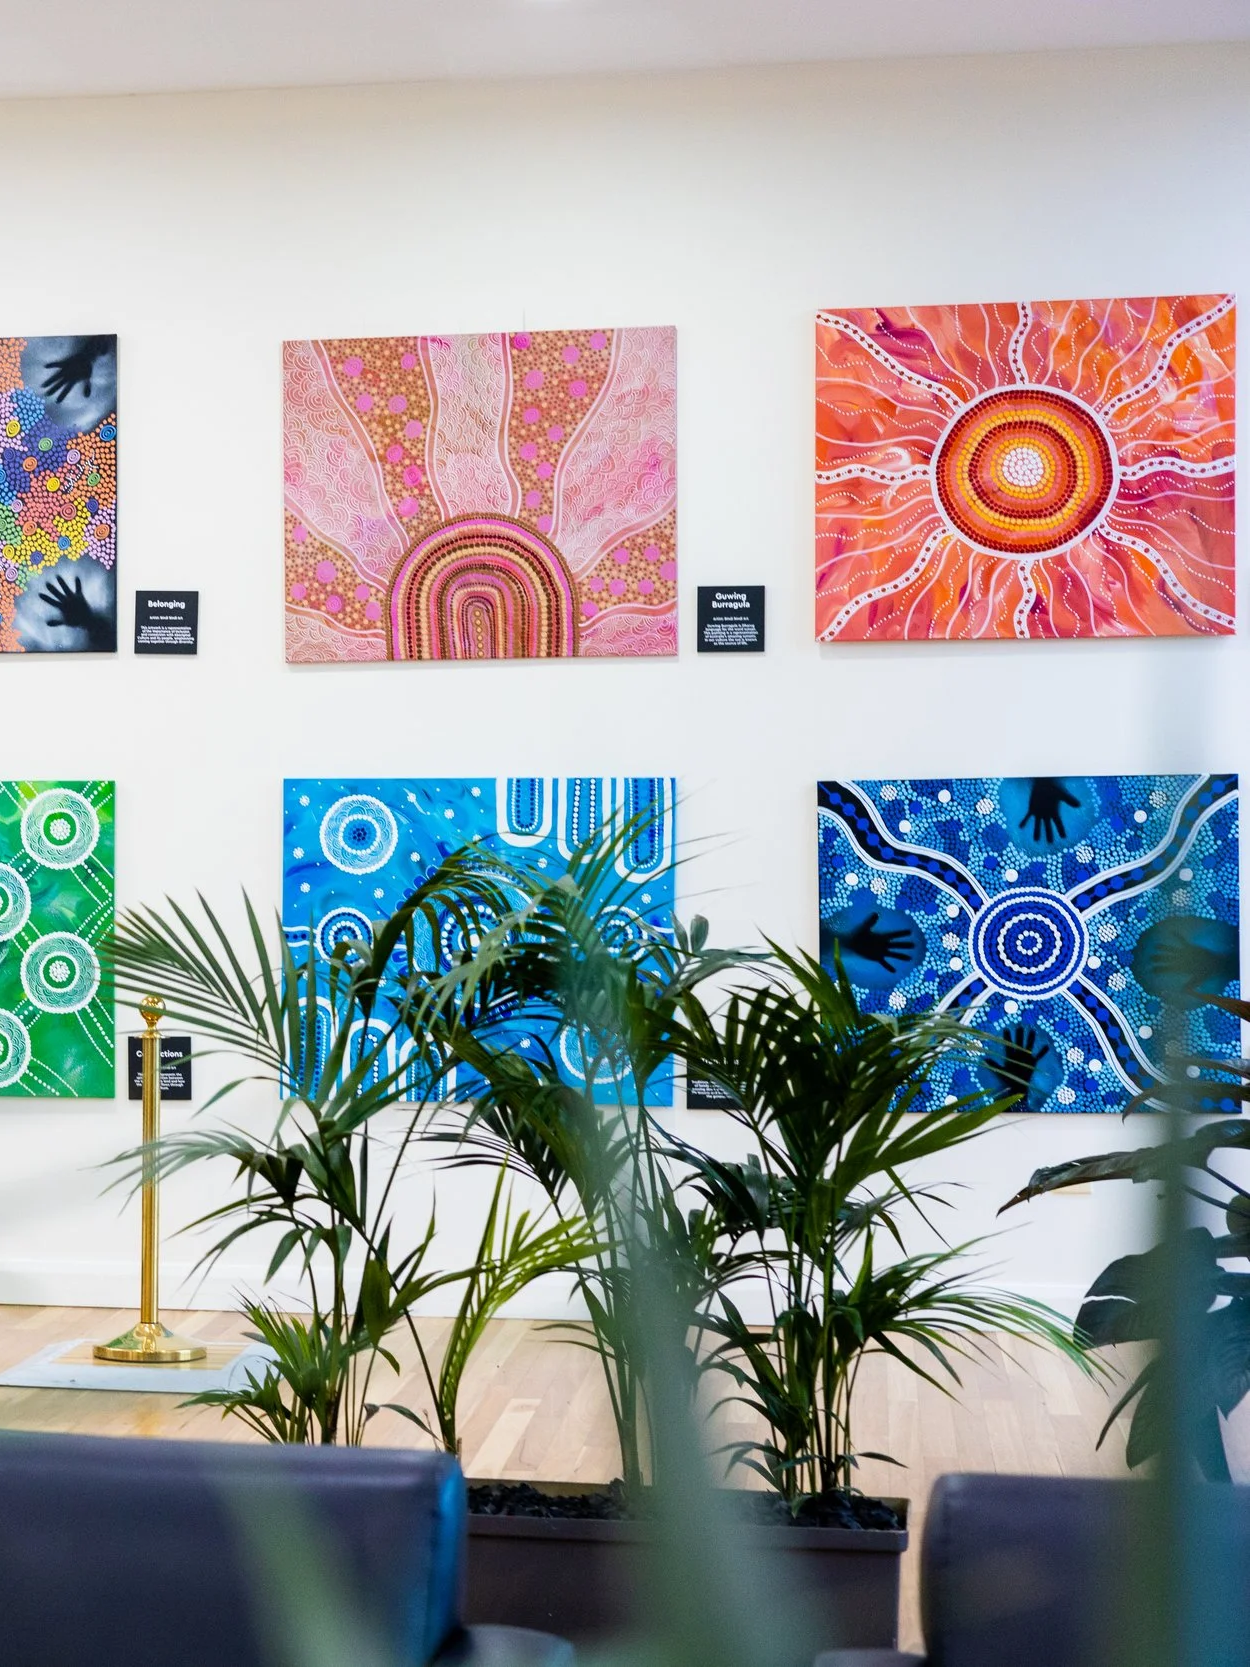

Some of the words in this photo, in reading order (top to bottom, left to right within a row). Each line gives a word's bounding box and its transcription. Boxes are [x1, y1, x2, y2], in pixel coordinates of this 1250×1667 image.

[716, 592, 746, 600] Guwing
[148, 600, 186, 609] Belonging
[712, 600, 750, 609] Burragula
